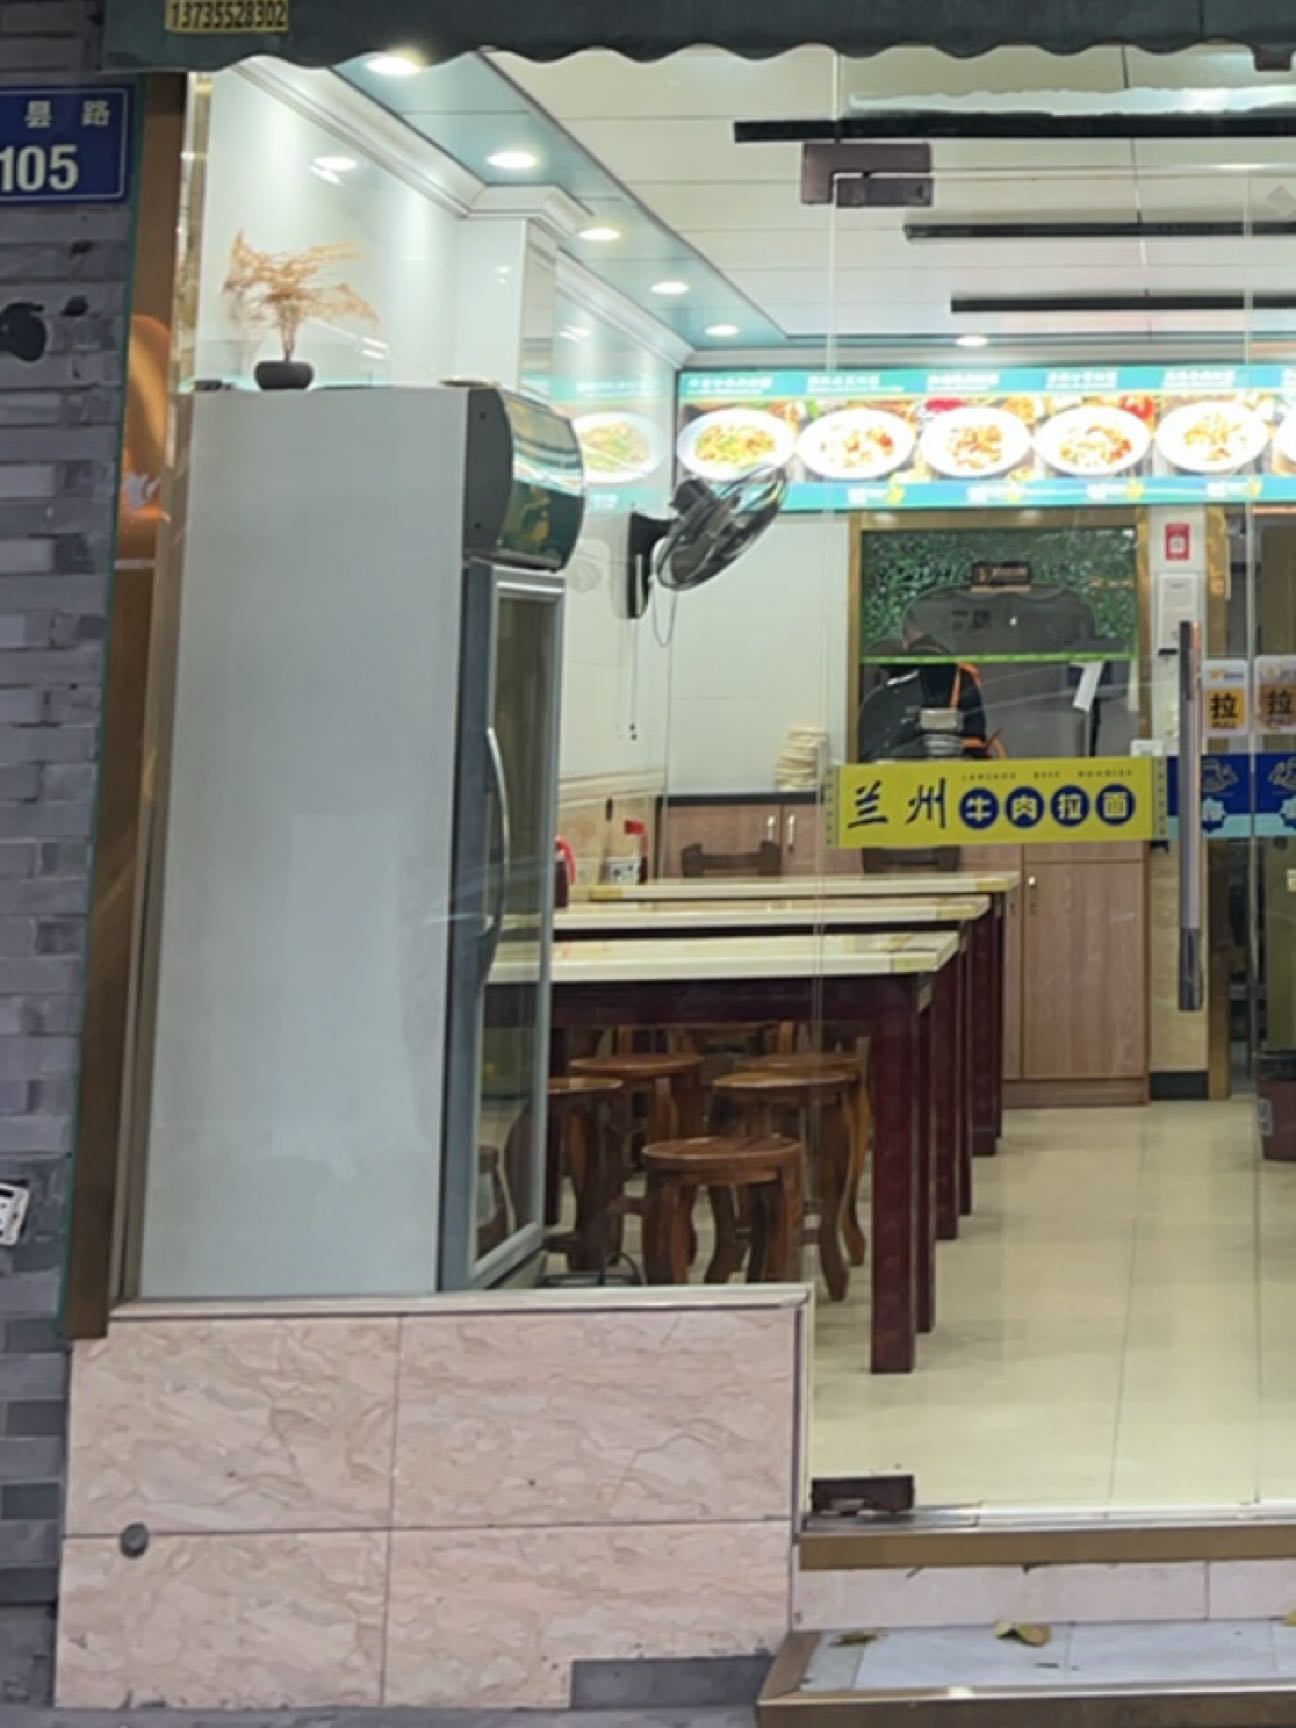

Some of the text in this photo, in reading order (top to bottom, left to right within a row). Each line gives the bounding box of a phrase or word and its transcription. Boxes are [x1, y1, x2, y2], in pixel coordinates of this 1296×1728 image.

[172, 0, 285, 28] 13735528302
[0, 144, 79, 192] 105
[1210, 692, 1239, 721] 拉
[1264, 688, 1294, 716] 拉
